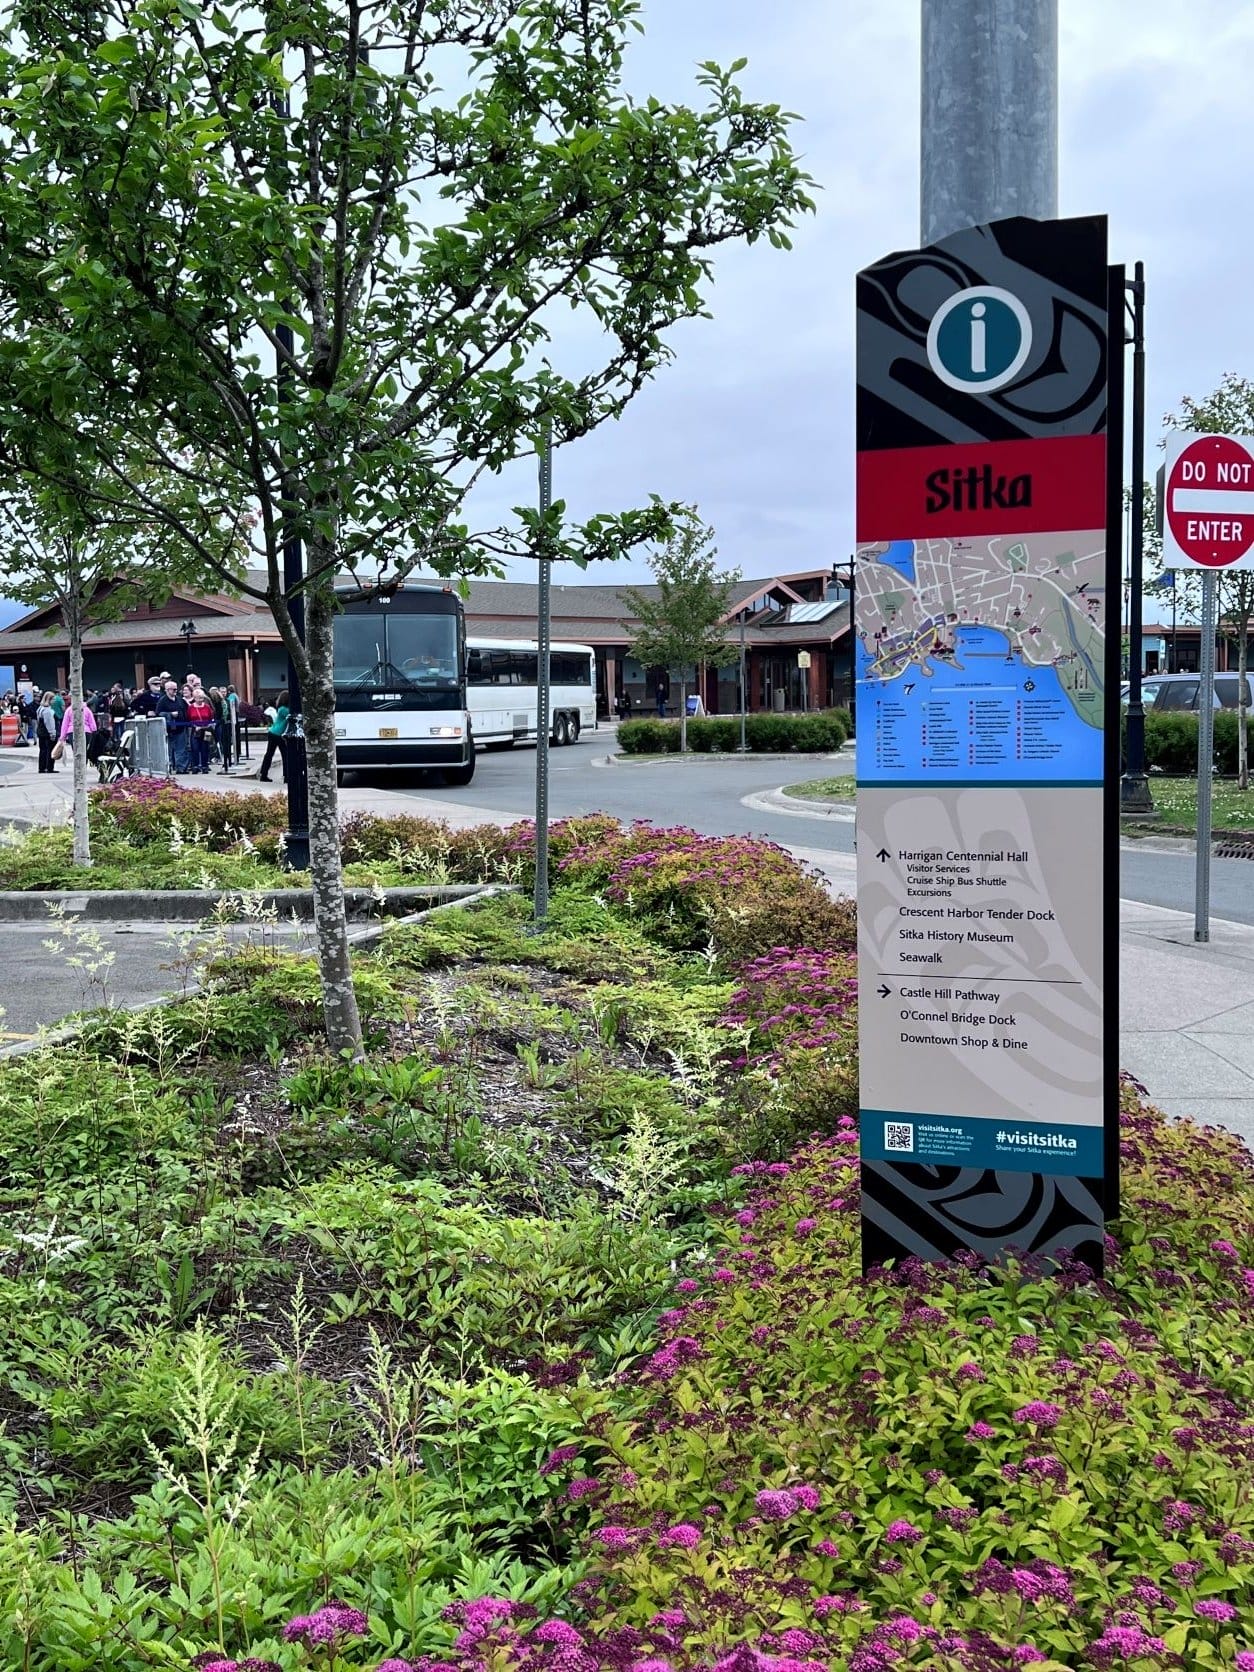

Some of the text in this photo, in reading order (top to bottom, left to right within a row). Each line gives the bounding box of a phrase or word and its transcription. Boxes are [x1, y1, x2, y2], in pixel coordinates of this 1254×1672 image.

[1182, 461, 1252, 484] DO NOT
[925, 463, 1033, 514] Sitka
[1187, 520, 1243, 542] ENTER
[899, 850, 1028, 864] Harrigan Centennial Hall
[907, 864, 970, 873] Visitor Services
[907, 876, 1007, 887] Cruise Ship Bus Shuttle
[907, 888, 952, 897] Excursions
[899, 907, 1055, 920] Crescent Harbor Tender Dock
[899, 929, 1014, 943] Sitka History Museum
[899, 952, 943, 963] Seawalk
[900, 987, 1000, 1003] Castle Hill Pathway
[900, 1010, 1016, 1026] O'Connel Bridge Dock
[900, 1033, 1028, 1049] Downtown Shop & Dine
[918, 1124, 963, 1135] visitsitka.org
[995, 1130, 1077, 1149] #visitsitka
